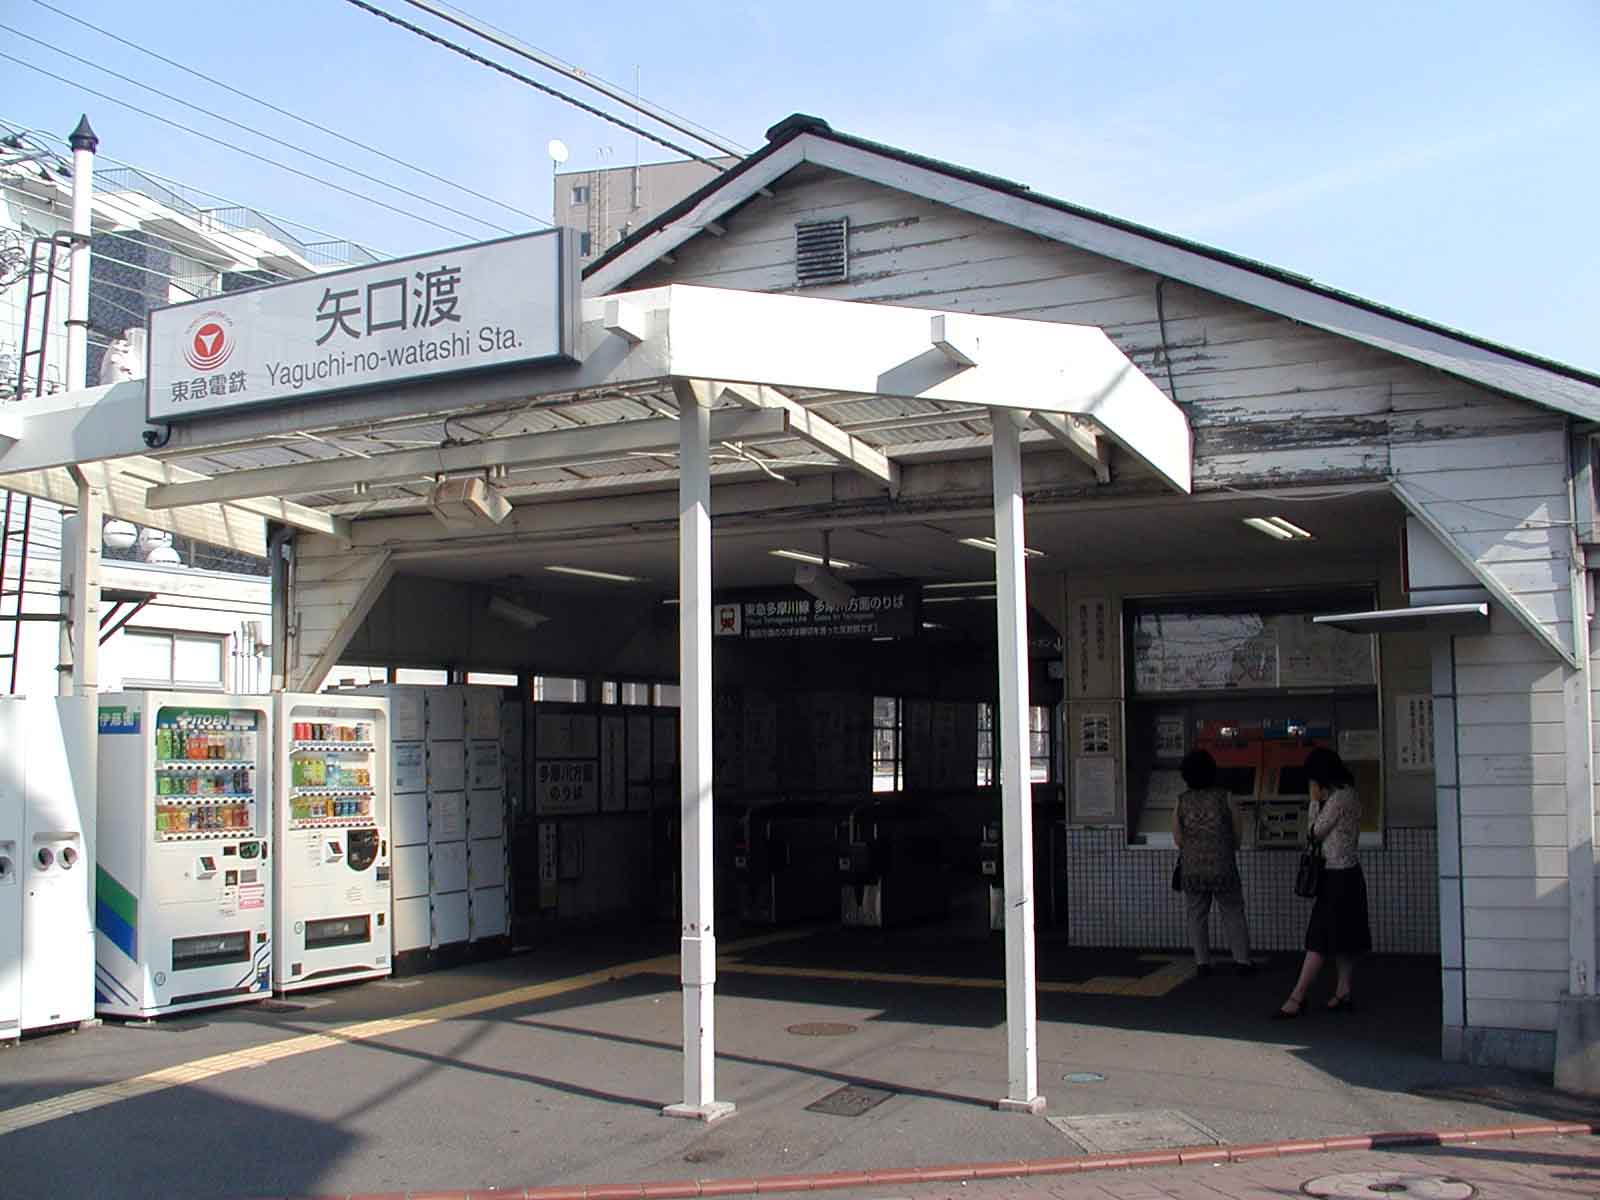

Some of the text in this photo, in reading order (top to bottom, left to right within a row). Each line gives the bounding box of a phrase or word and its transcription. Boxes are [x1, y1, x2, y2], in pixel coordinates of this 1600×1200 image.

[315, 265, 462, 346] 矢口渡
[170, 370, 247, 403] 東急電鉄
[266, 326, 523, 390] Yaguchi-no-watashi Sta.
